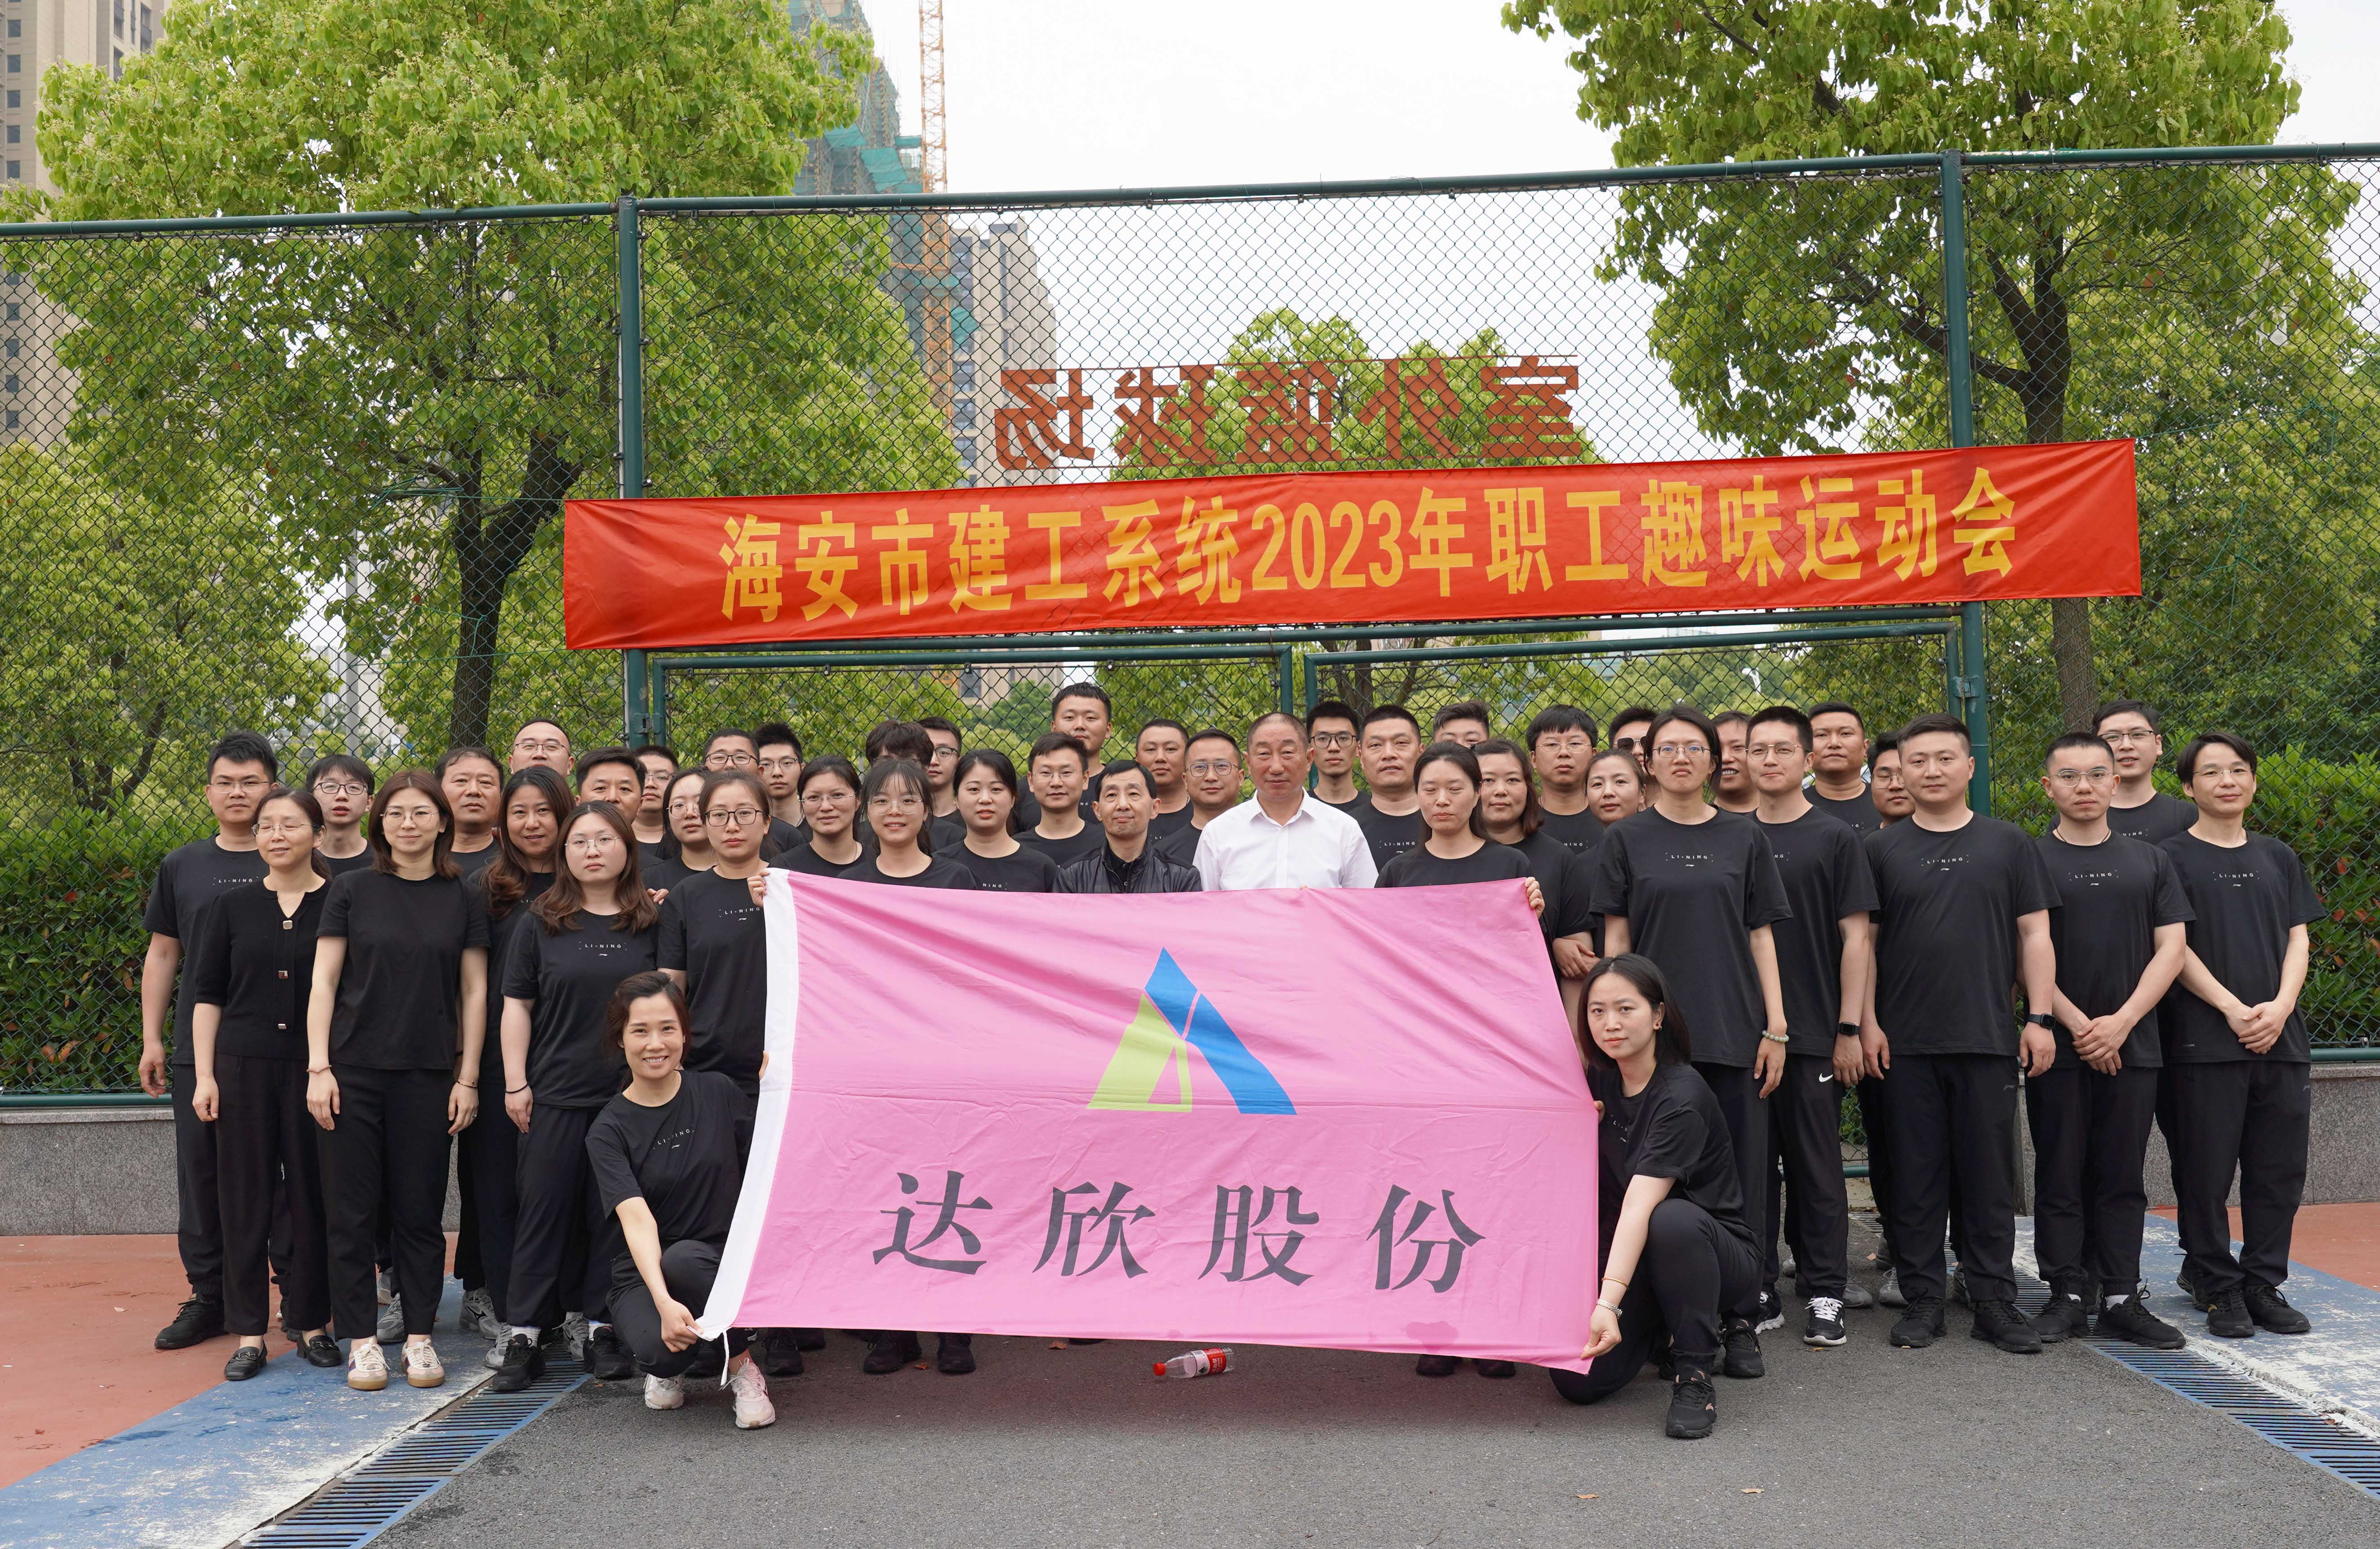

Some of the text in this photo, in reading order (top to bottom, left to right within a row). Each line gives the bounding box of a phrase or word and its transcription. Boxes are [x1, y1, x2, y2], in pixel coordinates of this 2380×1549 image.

[720, 466, 2016, 621] 海安市建工系统2023年职工趣味运动会
[1926, 857, 1964, 865] LI-NING
[724, 906, 761, 915] LI-NING
[872, 1170, 1486, 1294] 达欣股份
